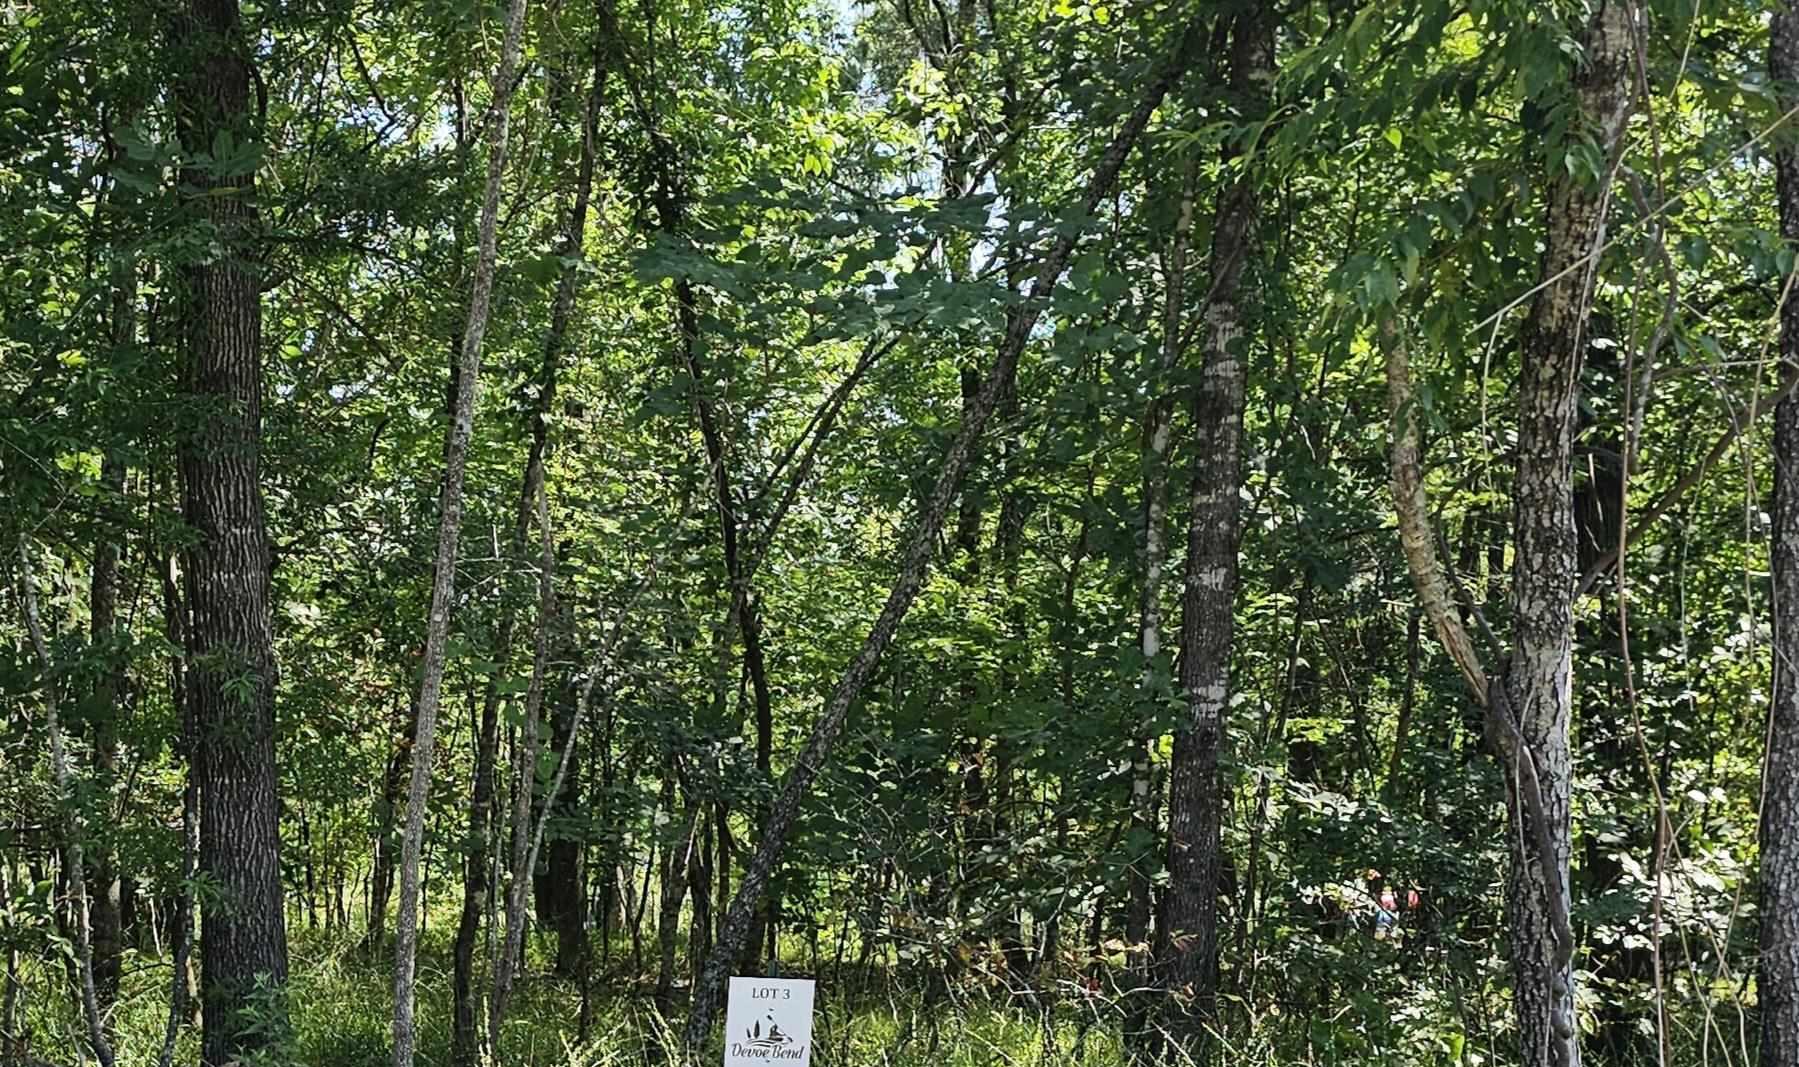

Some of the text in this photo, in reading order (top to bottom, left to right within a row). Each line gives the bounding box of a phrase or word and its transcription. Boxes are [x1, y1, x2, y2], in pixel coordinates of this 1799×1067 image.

[752, 987, 790, 1000] LOT 3
[731, 1042, 804, 1060] Devoe Bend
